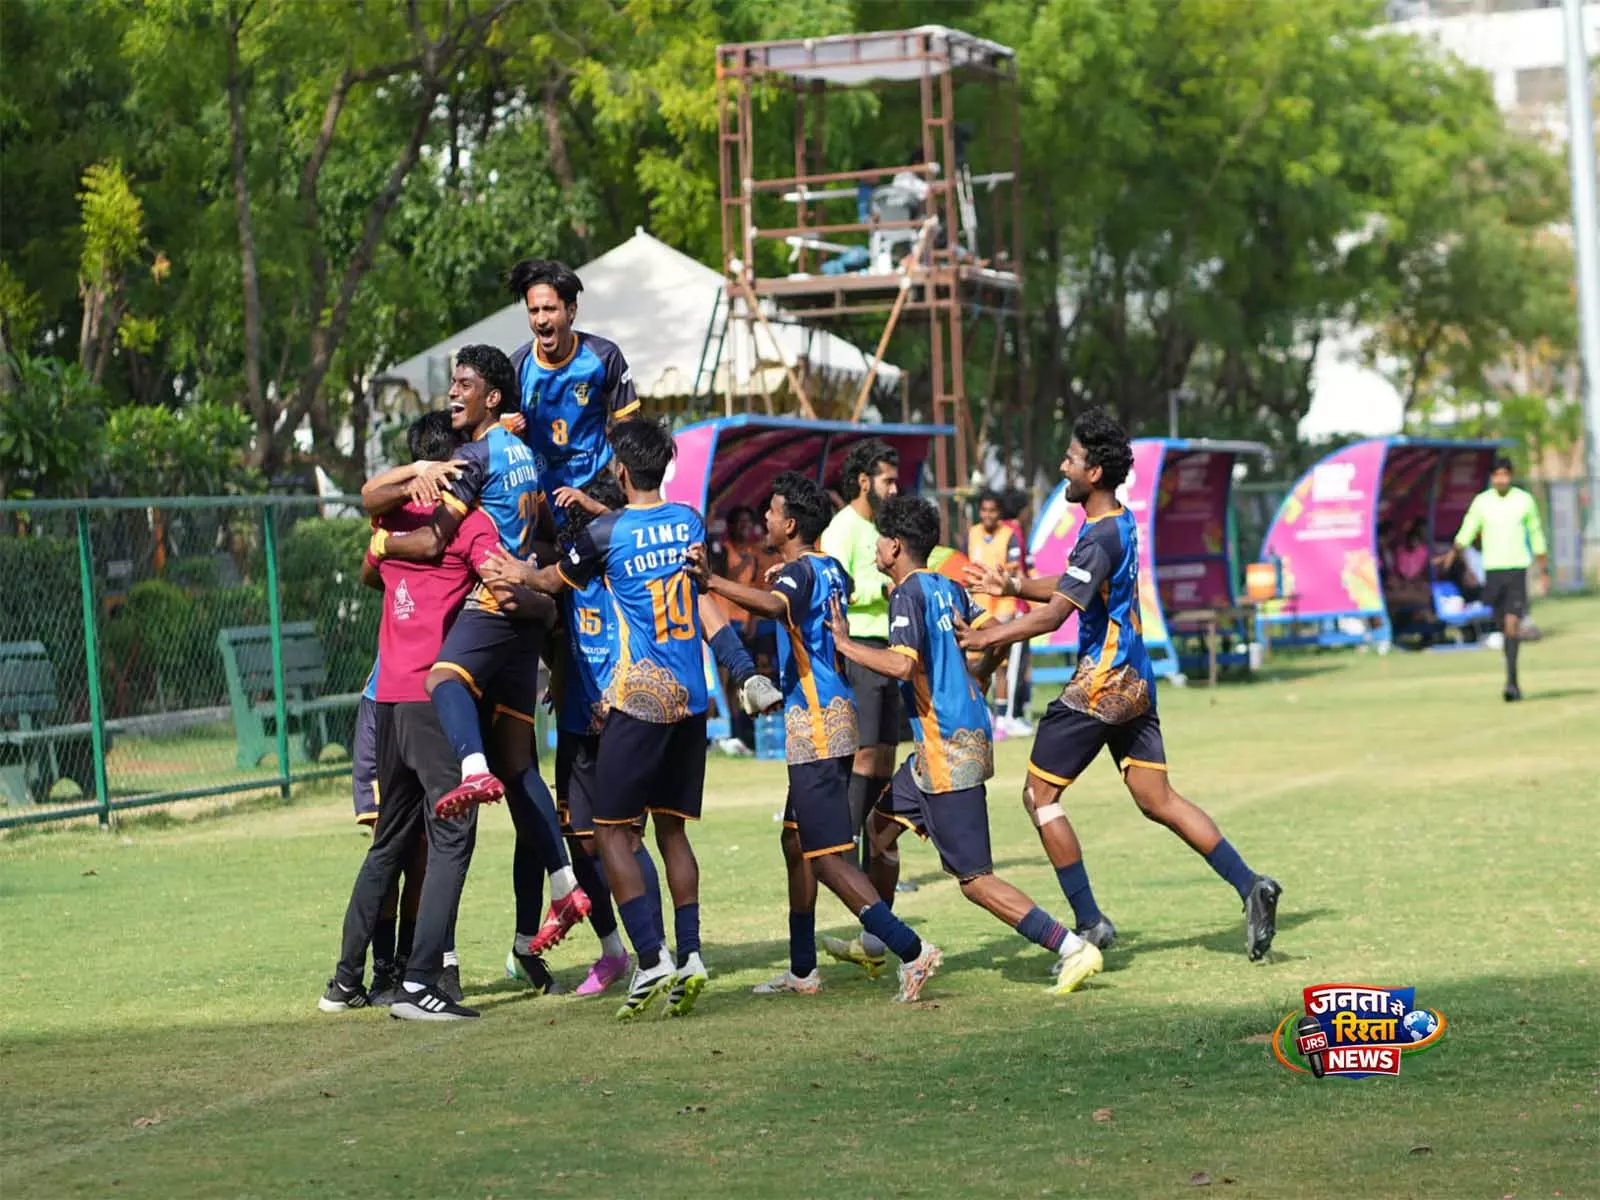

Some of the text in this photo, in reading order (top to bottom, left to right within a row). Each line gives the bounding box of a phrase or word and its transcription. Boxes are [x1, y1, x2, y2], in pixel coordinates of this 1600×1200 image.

[552, 418, 568, 446] 8
[632, 523, 689, 549] ZINC
[624, 547, 687, 576] FOOTBA
[578, 607, 602, 635] 15
[645, 572, 695, 644] 19
